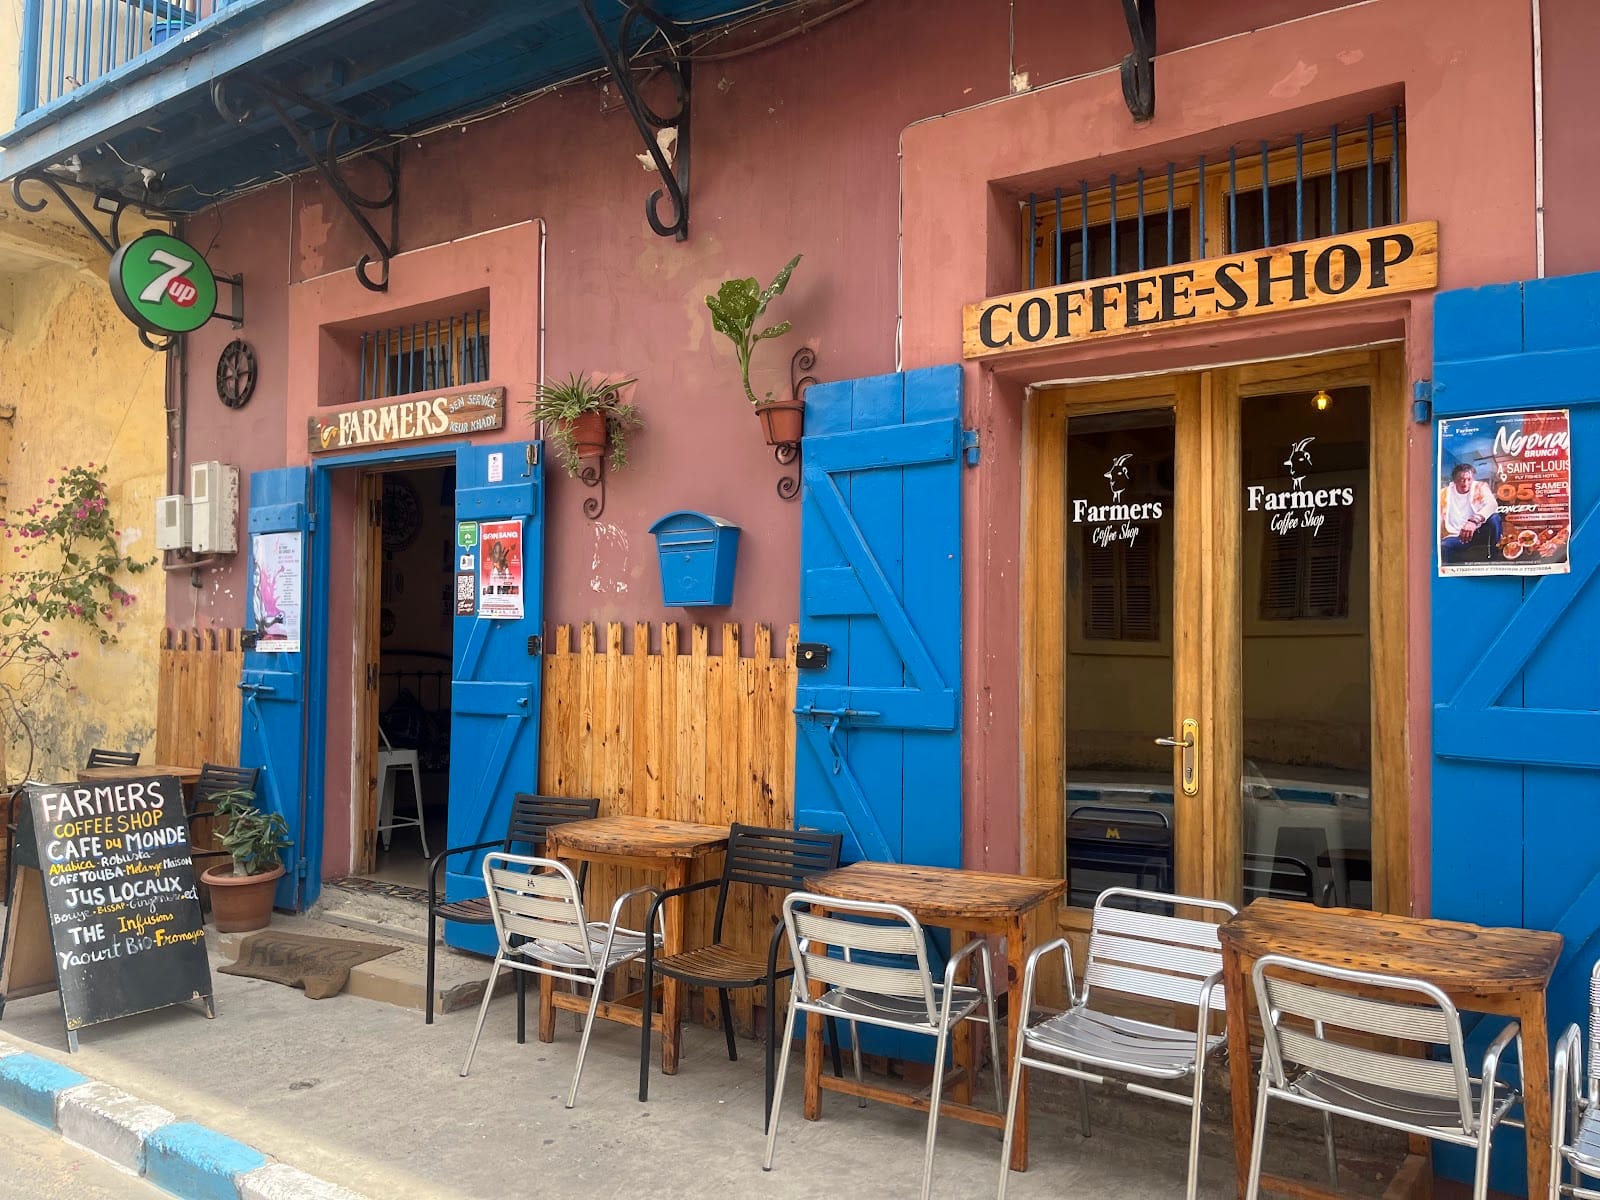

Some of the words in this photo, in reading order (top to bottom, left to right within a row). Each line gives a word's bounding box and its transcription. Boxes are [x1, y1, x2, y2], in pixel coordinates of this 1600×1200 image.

[979, 234, 1414, 348] COFFEE-SHOP
[338, 397, 449, 446] FARMERS
[1525, 449, 1559, 457] BRUNCH
[1247, 486, 1354, 511] Farmers
[1497, 483, 1535, 501] 05
[1072, 499, 1163, 523] Farmers
[1271, 511, 1298, 535] Coffee
[1300, 506, 1325, 537] Shop
[1092, 525, 1117, 547] Coffee
[1119, 520, 1139, 547] Shop
[41, 782, 164, 821] FARMERS
[54, 817, 113, 838] COFFEE
[117, 809, 163, 832] SHOP
[47, 837, 103, 862] CAFE
[126, 826, 186, 852] MONDE
[50, 872, 78, 886] CAFE
[65, 887, 105, 908] JUS
[108, 876, 183, 903] LOCAUX
[68, 923, 106, 946] THE
[117, 913, 175, 936] Infusions
[59, 934, 122, 970] Yaourt
